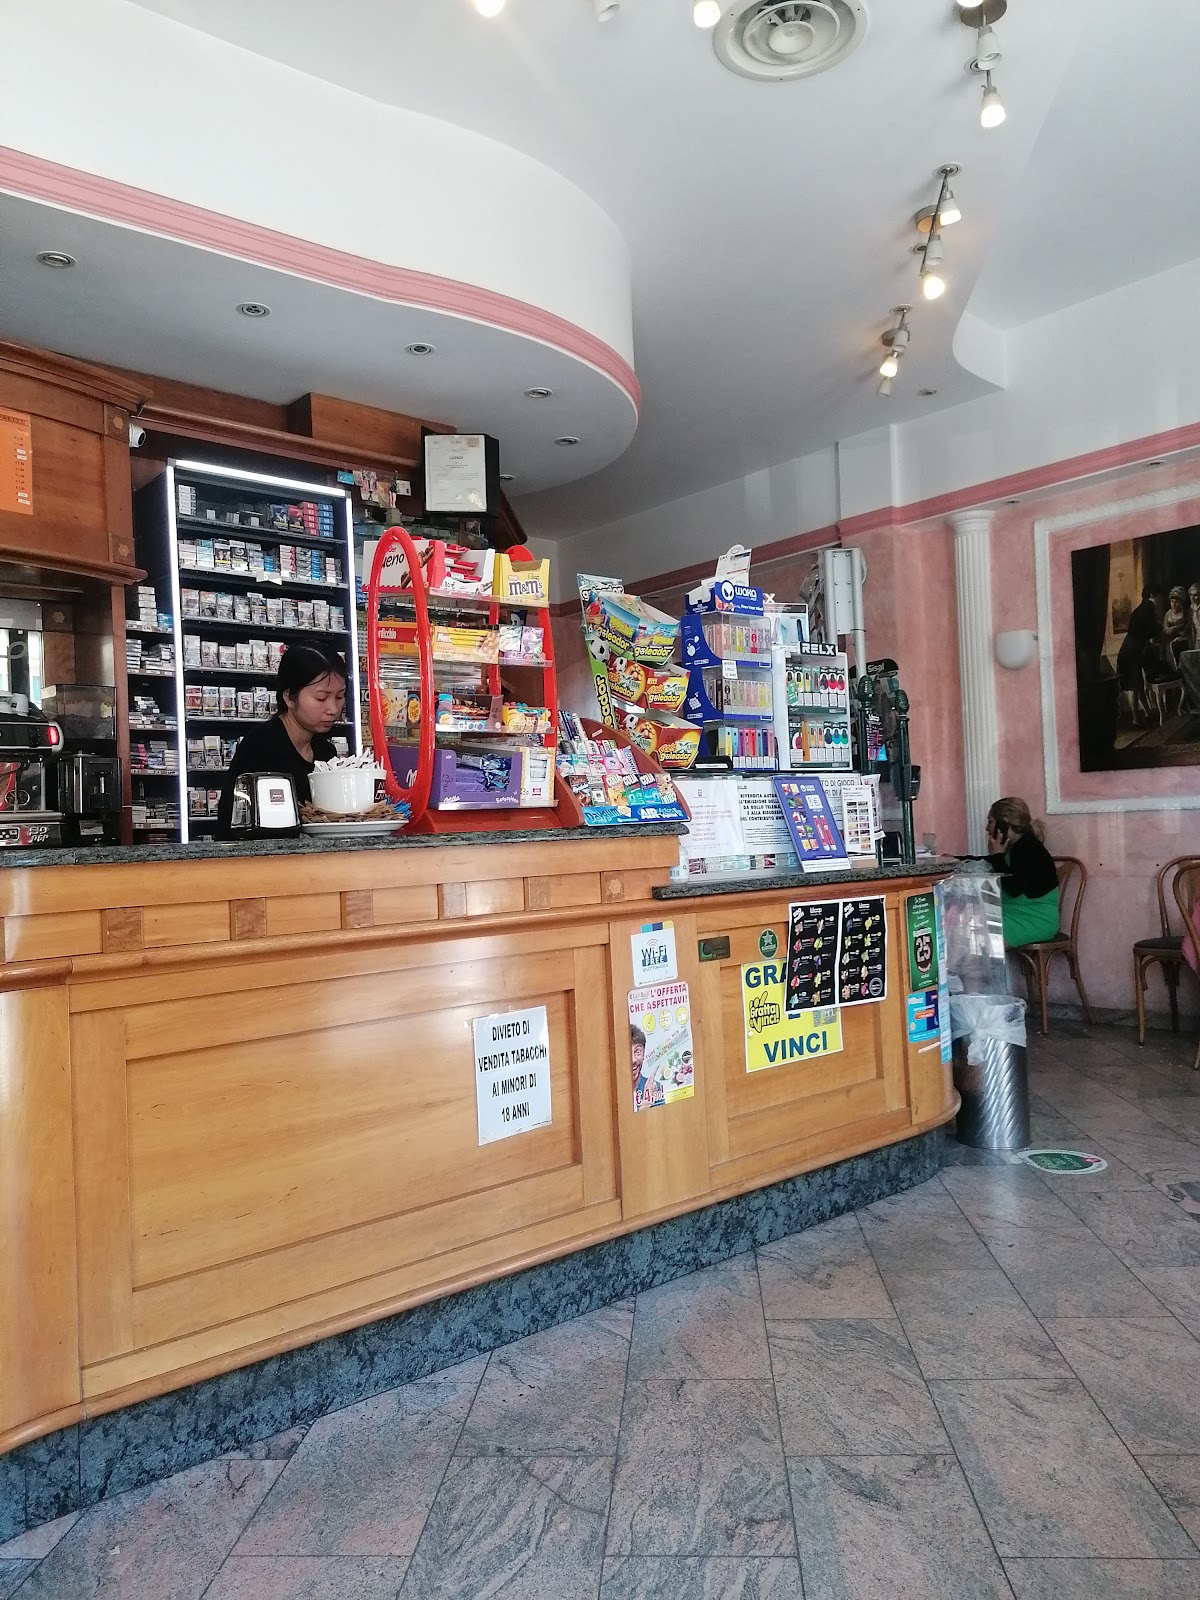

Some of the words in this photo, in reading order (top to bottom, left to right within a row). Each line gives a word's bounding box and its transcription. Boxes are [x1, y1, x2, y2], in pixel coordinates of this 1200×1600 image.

[634, 646, 671, 657] goleador
[801, 642, 835, 655] RELX
[867, 662, 885, 673] Sisal
[648, 693, 681, 704] goleador
[660, 752, 692, 761] goleador
[641, 945, 667, 959] Wi-Fi
[915, 935, 931, 963] 25
[645, 957, 665, 966] FREE
[650, 984, 687, 998] L'OFFERTA
[629, 1003, 645, 1014] CHE
[646, 994, 688, 1010] ASPETTAVI!
[750, 1003, 776, 1018] Gratta
[492, 1021, 520, 1041] DIVIETO
[522, 1019, 530, 1034] DI
[764, 1031, 828, 1063] VINCI
[478, 1052, 510, 1072] VENDITA
[511, 1044, 547, 1065] TABACCHI
[492, 1081, 500, 1097] AI
[501, 1074, 527, 1095] MINORI
[529, 1073, 537, 1088] DI
[501, 1106, 510, 1122] 18
[512, 1101, 530, 1120] ANNI
